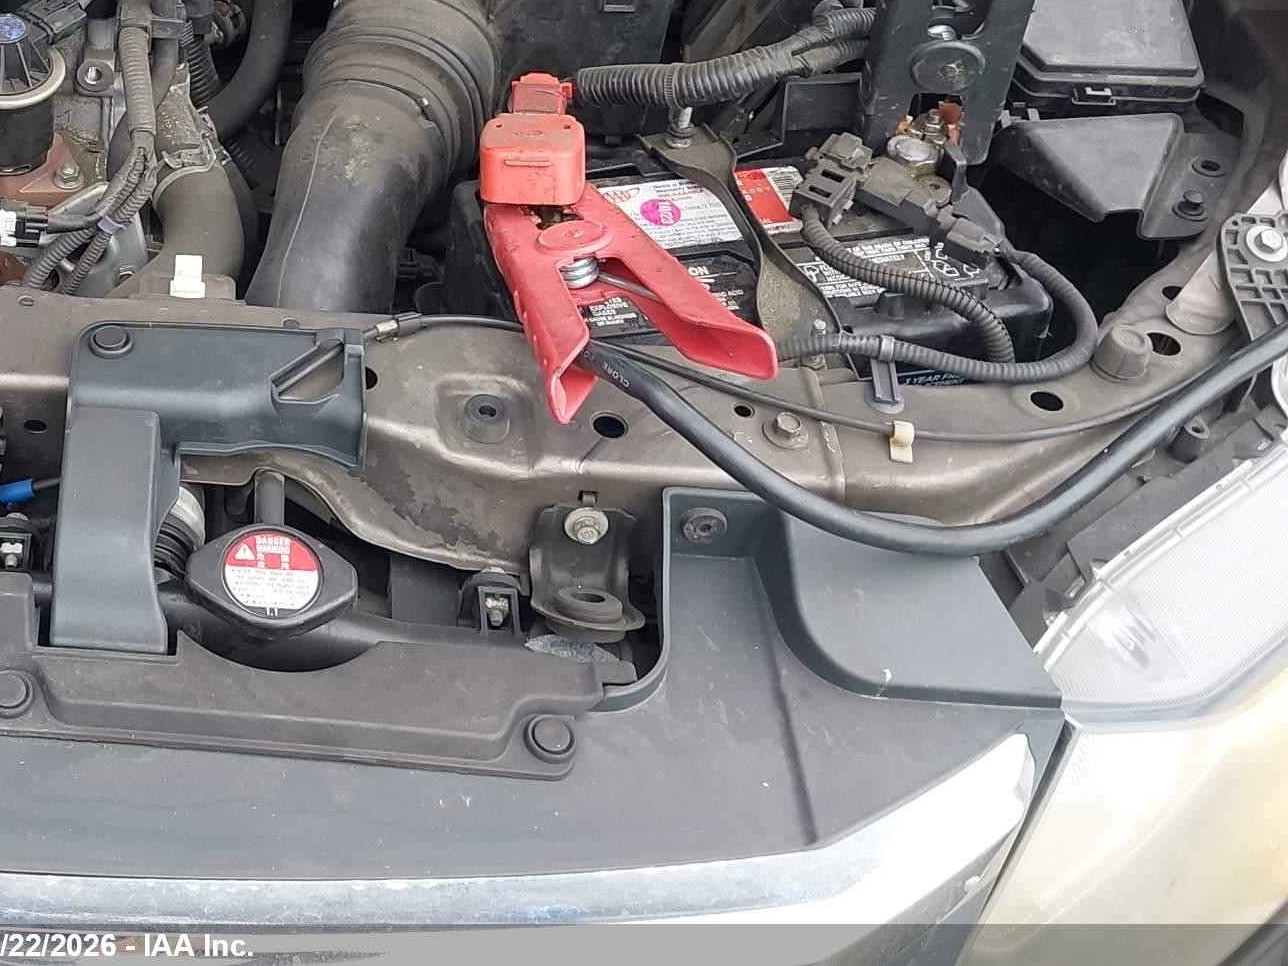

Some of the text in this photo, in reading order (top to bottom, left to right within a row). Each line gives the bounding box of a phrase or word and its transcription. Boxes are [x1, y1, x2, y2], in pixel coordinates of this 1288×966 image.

[589, 302, 629, 311] EXPLOSIVE
[592, 309, 616, 317] GASES
[602, 361, 630, 387] CLORE
[913, 374, 941, 384] YEAR
[255, 535, 292, 546] DANGER
